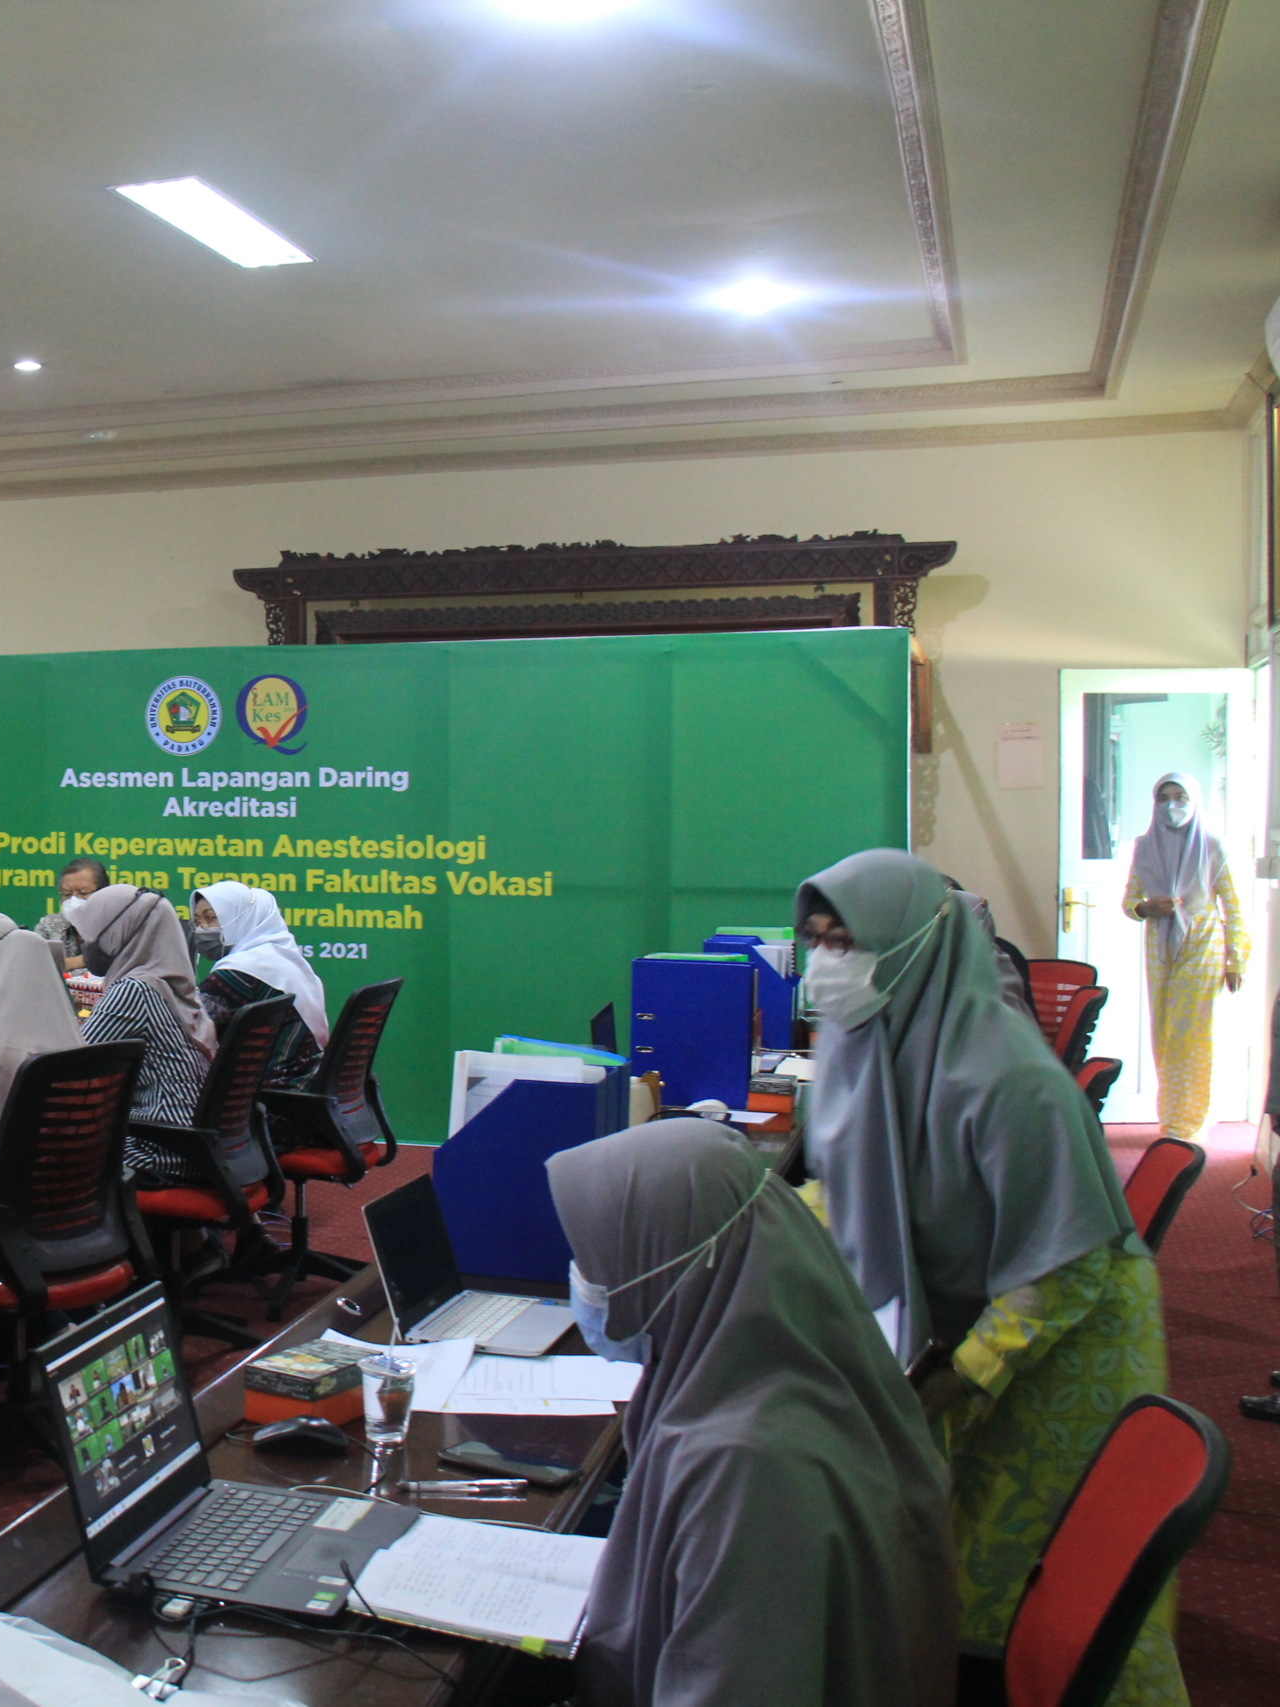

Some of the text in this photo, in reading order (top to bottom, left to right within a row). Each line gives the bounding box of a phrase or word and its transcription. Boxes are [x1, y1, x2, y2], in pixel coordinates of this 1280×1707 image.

[149, 681, 177, 728] UNIVERSITAS
[179, 679, 218, 728] BAITURRAHMAH
[252, 691, 291, 707] LAM
[252, 708, 282, 722] Kes
[162, 739, 205, 753] PADANG
[61, 767, 410, 793] Asesmen Lapangan Daring
[163, 796, 297, 818] Akreditasi
[74, 832, 264, 860] Keperawatan
[272, 834, 486, 864] Anestesiologi
[306, 868, 437, 895] Fakultas
[446, 870, 553, 897] Vokasi
[319, 942, 368, 960] 2021
